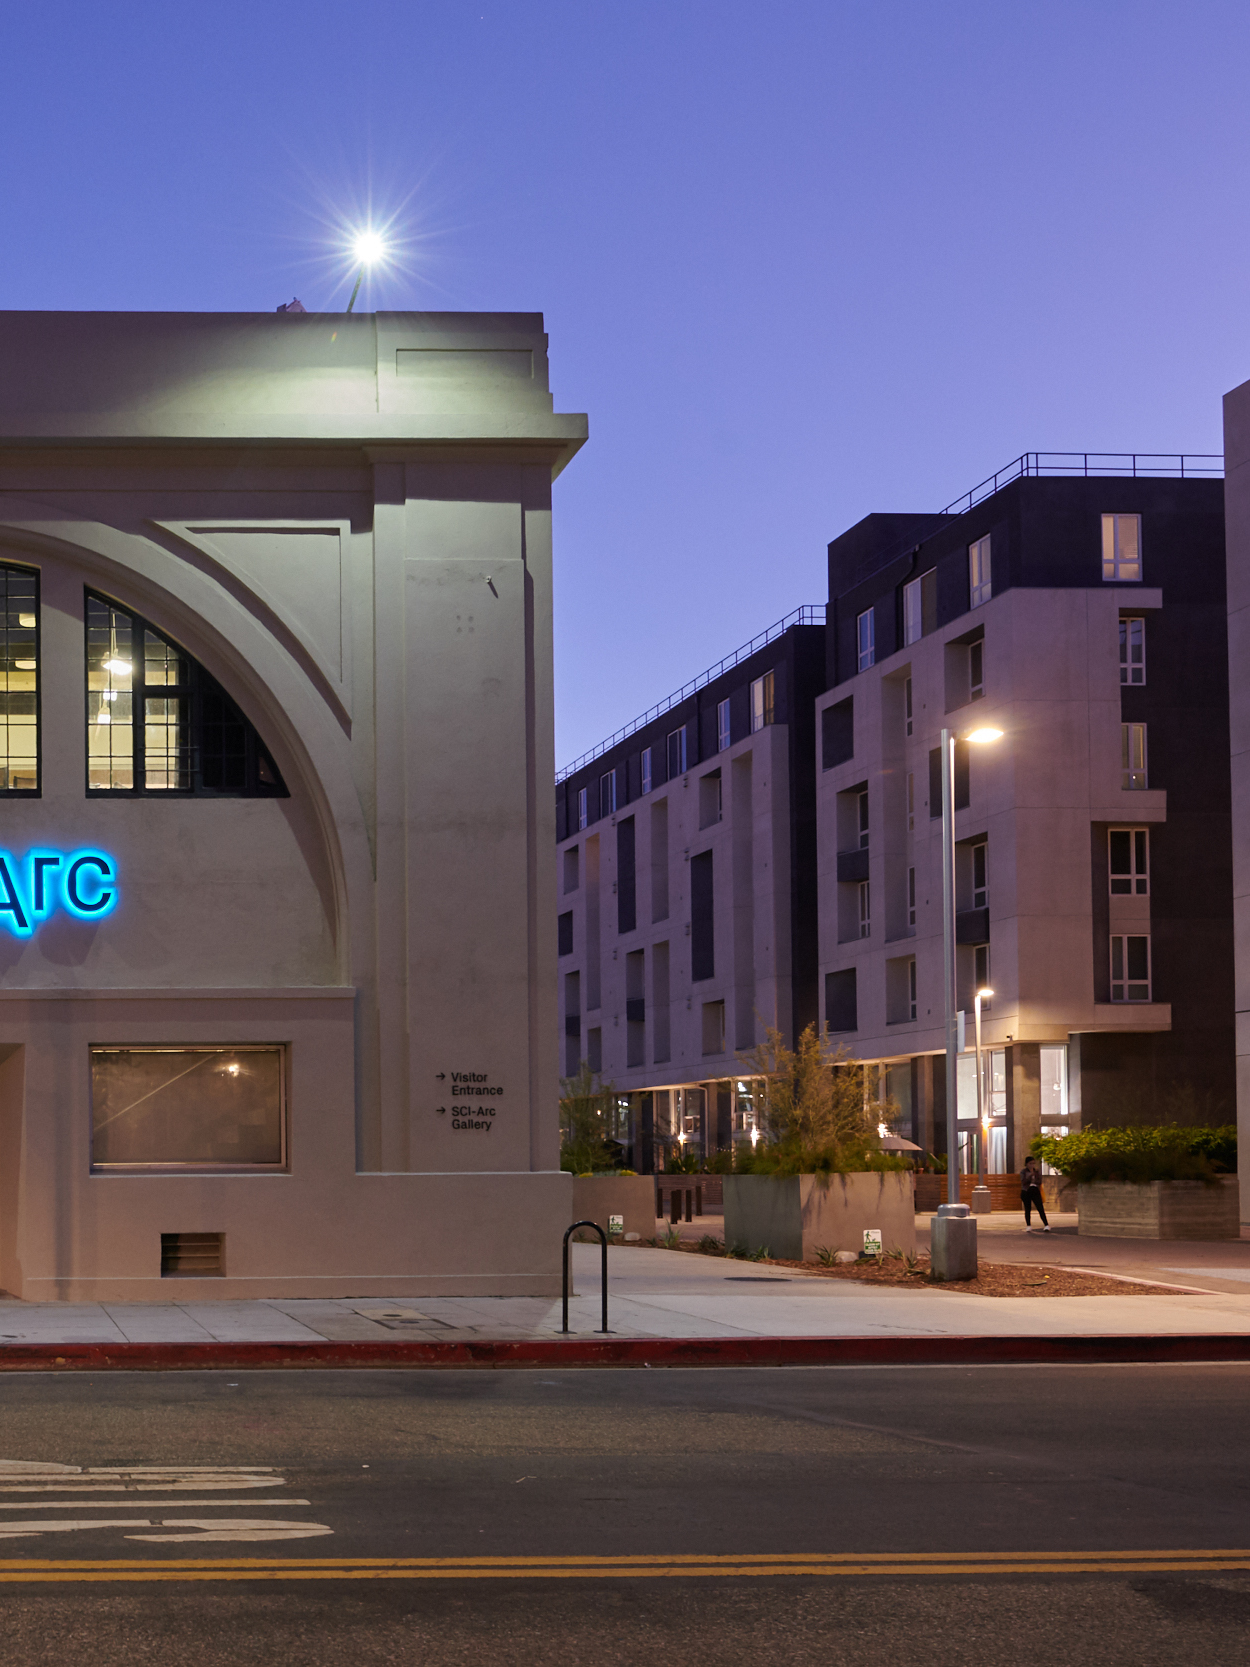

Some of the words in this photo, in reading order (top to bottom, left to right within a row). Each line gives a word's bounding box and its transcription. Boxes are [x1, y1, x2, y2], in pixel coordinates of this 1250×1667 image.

[451, 1072, 488, 1083] Visitor
[451, 1085, 504, 1096] Entrance
[451, 1106, 496, 1117] SCI-Arc
[451, 1119, 492, 1132] Gallery
